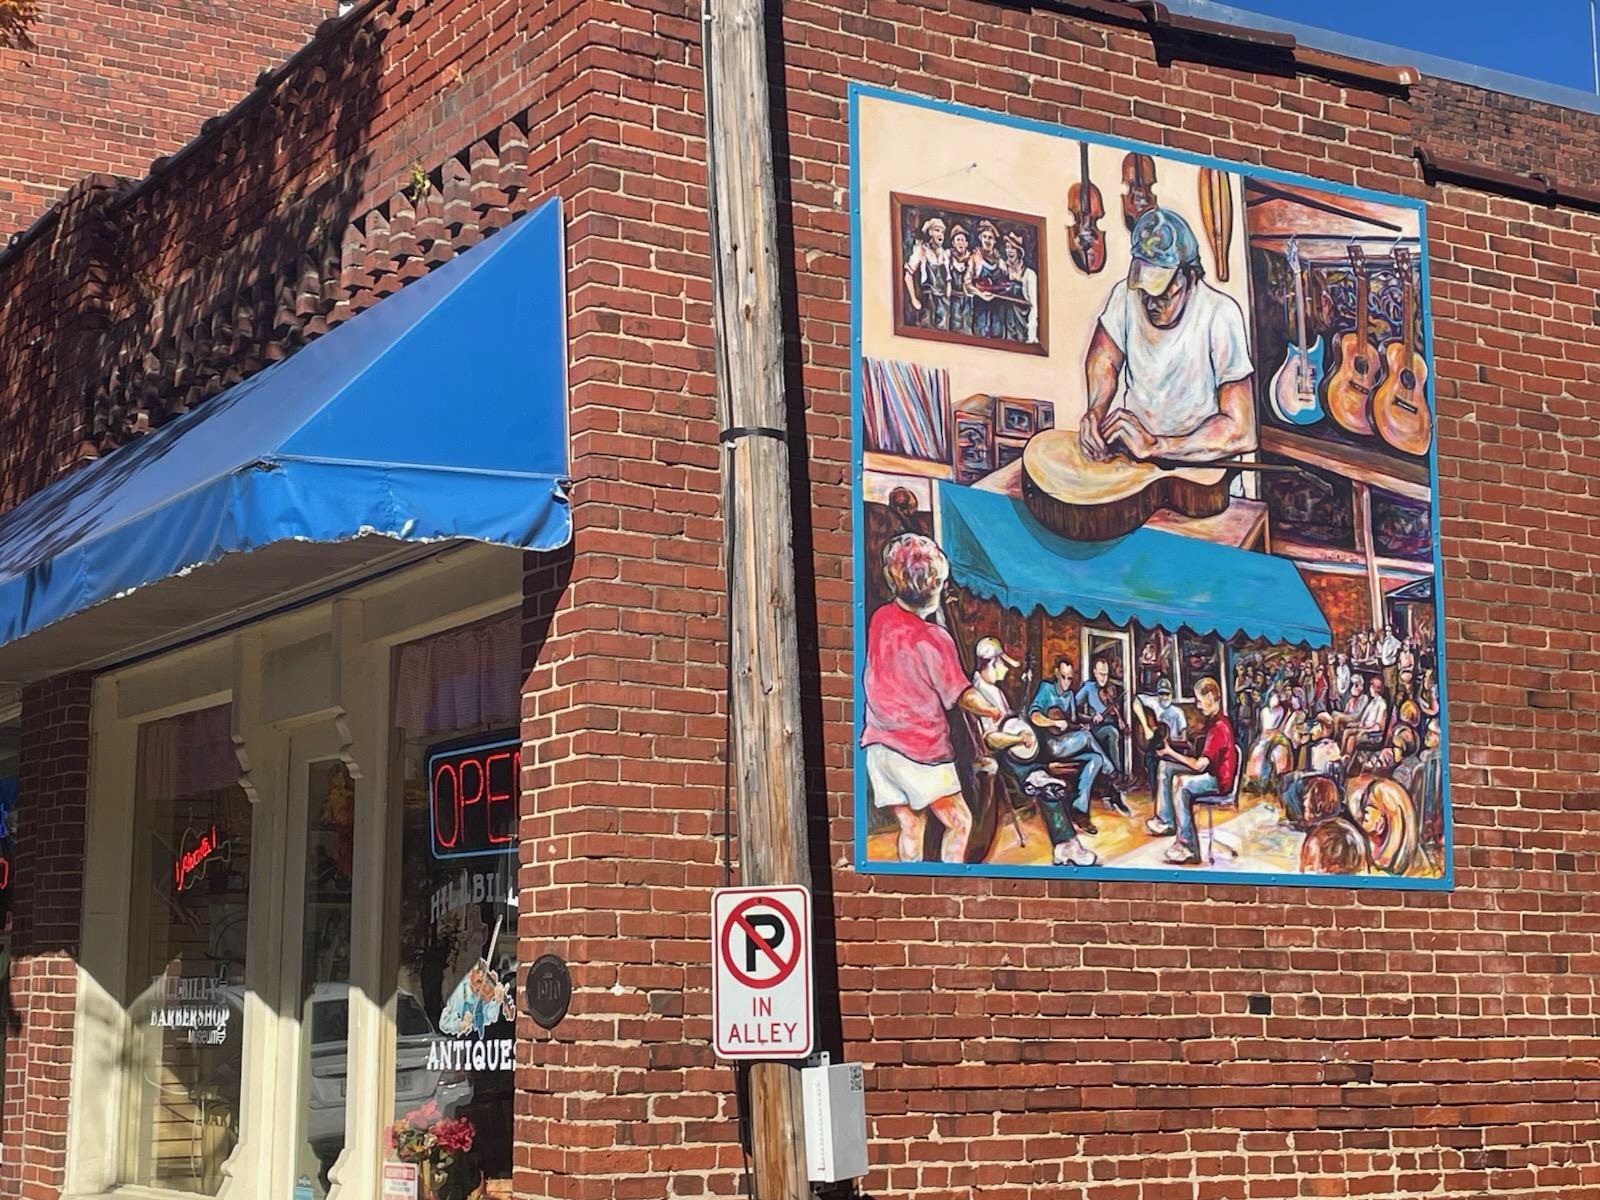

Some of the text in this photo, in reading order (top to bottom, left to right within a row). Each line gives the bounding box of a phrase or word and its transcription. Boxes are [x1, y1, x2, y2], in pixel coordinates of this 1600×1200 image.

[429, 868, 519, 926] HILLBILL
[149, 1004, 230, 1030] BARBERSHOP
[752, 996, 773, 1017] IN
[728, 1022, 798, 1043] ALLEY
